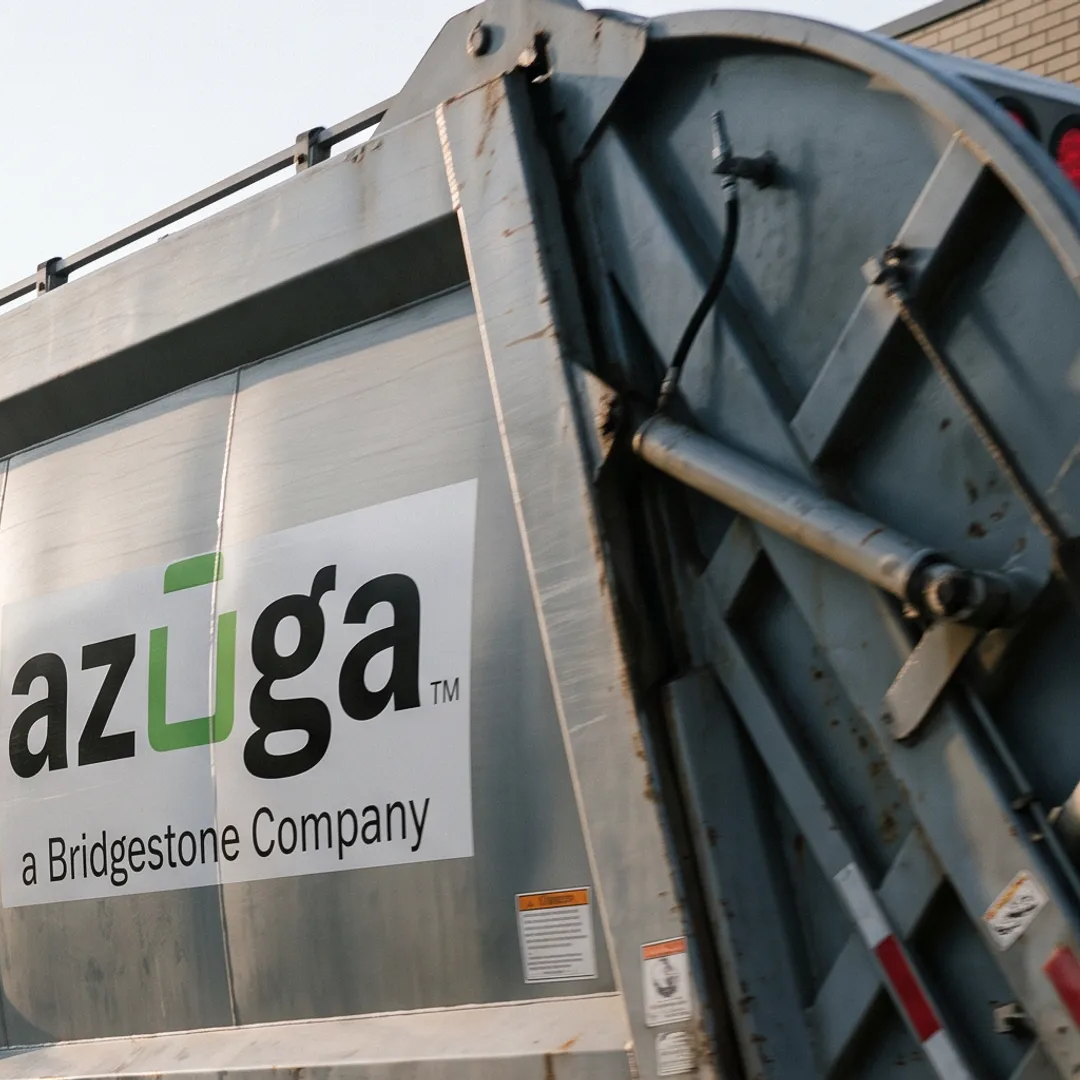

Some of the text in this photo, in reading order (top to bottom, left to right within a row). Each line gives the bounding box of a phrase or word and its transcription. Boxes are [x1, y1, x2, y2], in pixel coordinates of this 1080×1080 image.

[22, 798, 431, 886] a Bridgestone Company
